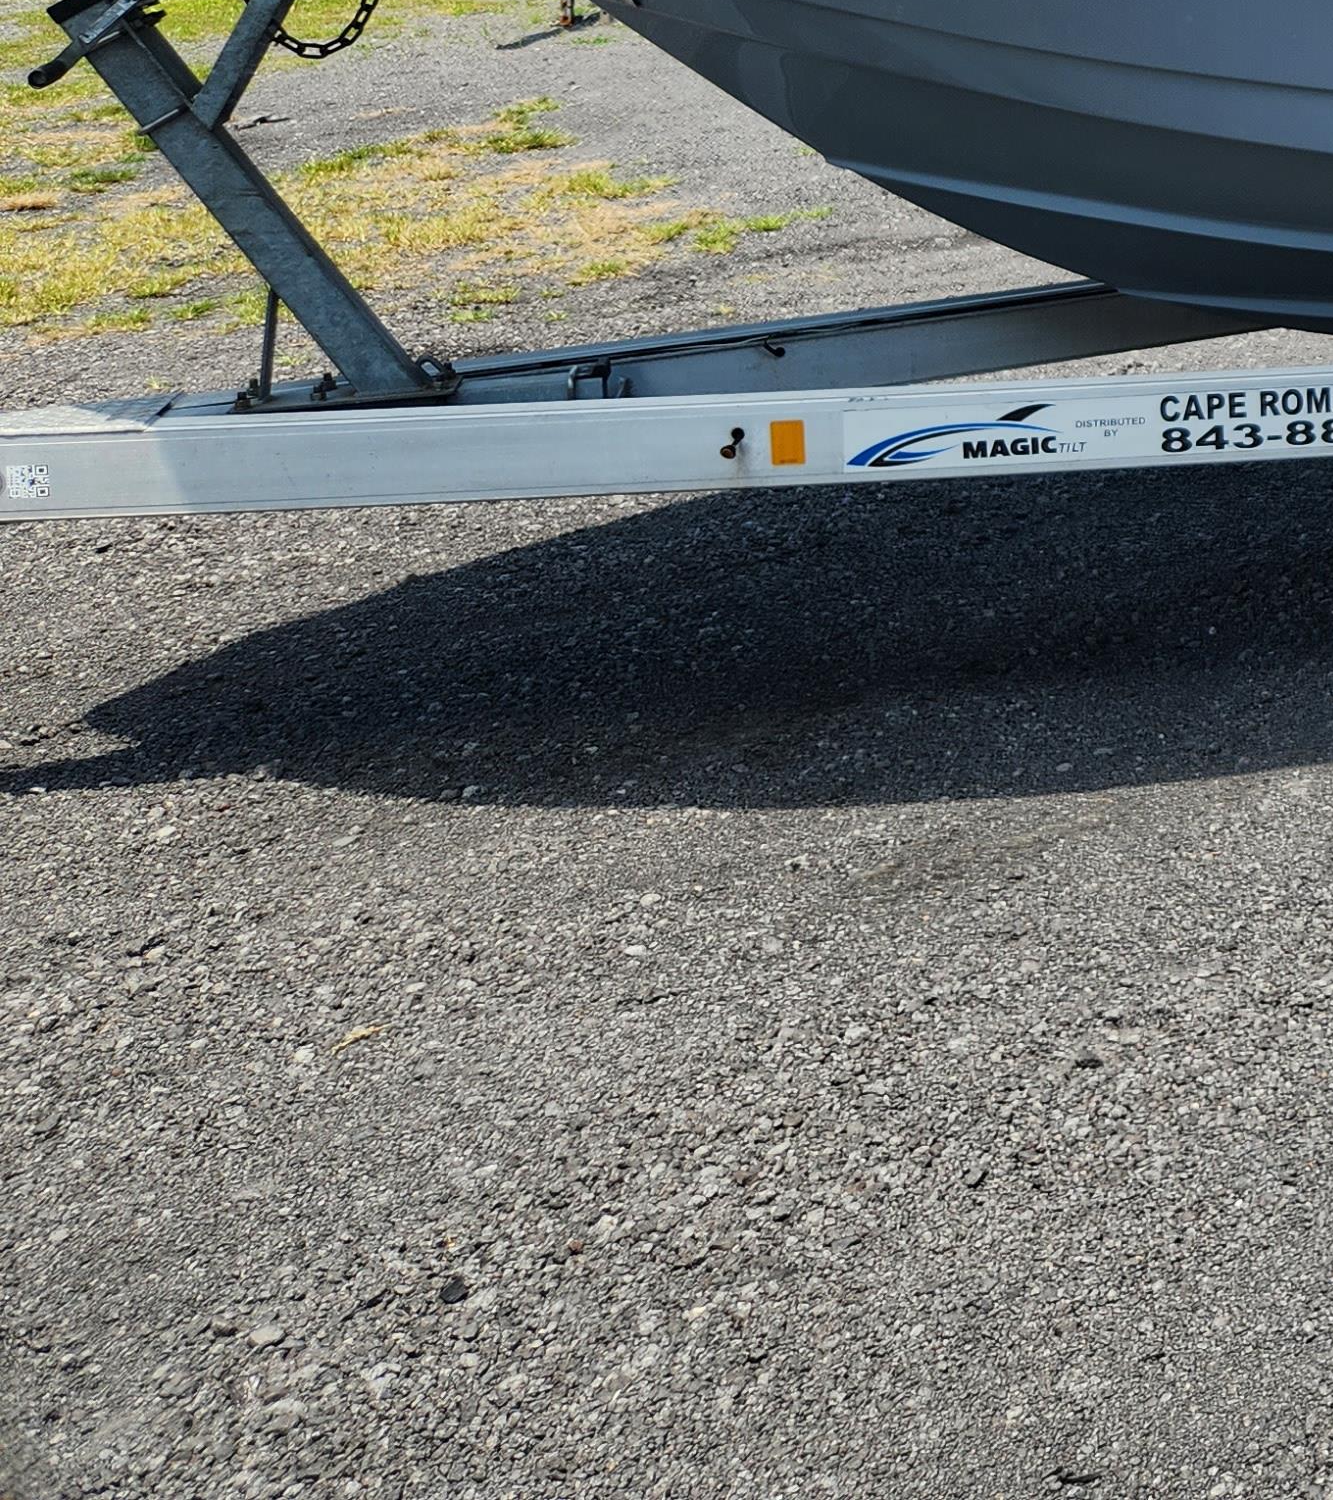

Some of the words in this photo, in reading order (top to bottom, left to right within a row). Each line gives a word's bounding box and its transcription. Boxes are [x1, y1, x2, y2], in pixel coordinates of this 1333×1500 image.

[1160, 392, 1248, 422] CAPE
[1075, 417, 1146, 429] DISTRIBUTED
[1104, 429, 1118, 438] BY
